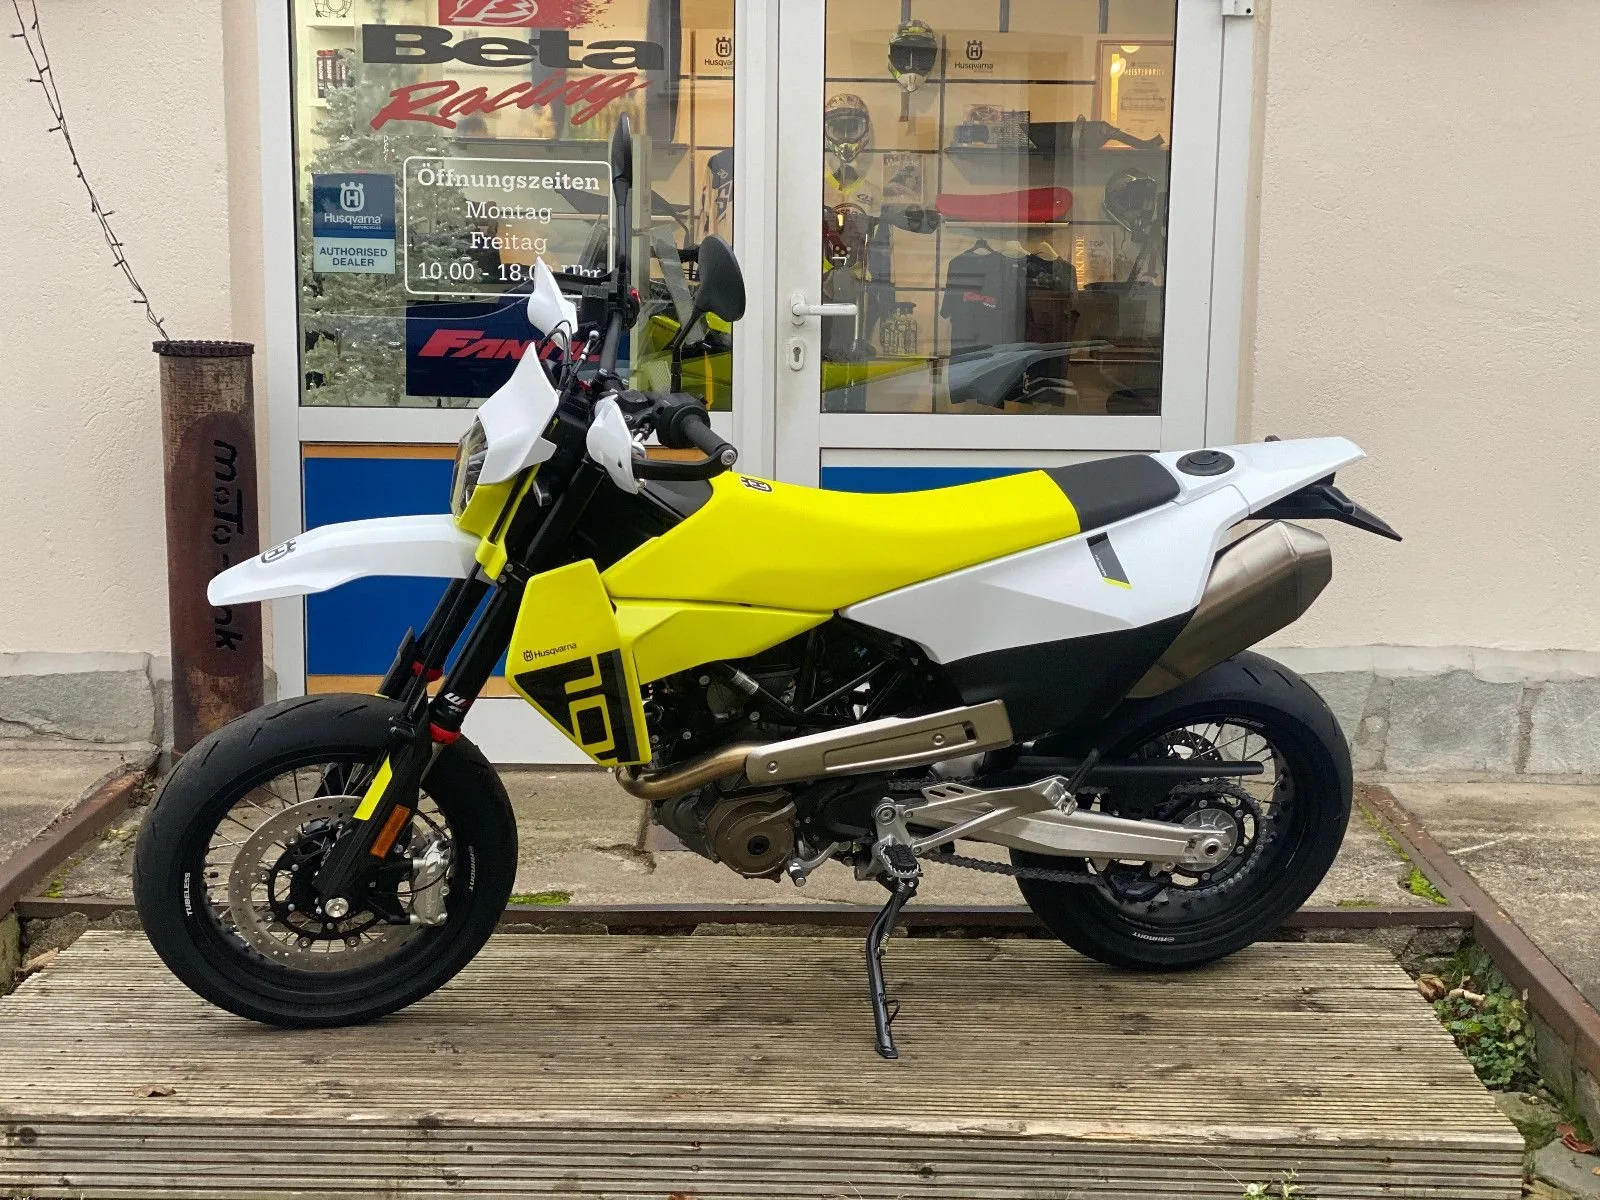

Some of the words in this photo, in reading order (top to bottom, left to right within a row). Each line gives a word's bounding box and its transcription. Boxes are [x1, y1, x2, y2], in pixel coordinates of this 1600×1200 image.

[362, 24, 664, 71] Beta
[369, 69, 654, 131] Racing
[417, 163, 600, 192] Öffnungszeiten
[324, 212, 381, 224] Husqvarna
[465, 201, 553, 224] Montag
[319, 247, 388, 258] AUTHORISED
[470, 232, 548, 255] Freitag
[332, 258, 375, 267] DEALER
[418, 262, 475, 281] 10.00
[498, 263, 554, 282] 18.0
[533, 642, 577, 659] Husqvarna
[183, 872, 193, 917] TUBELESS
